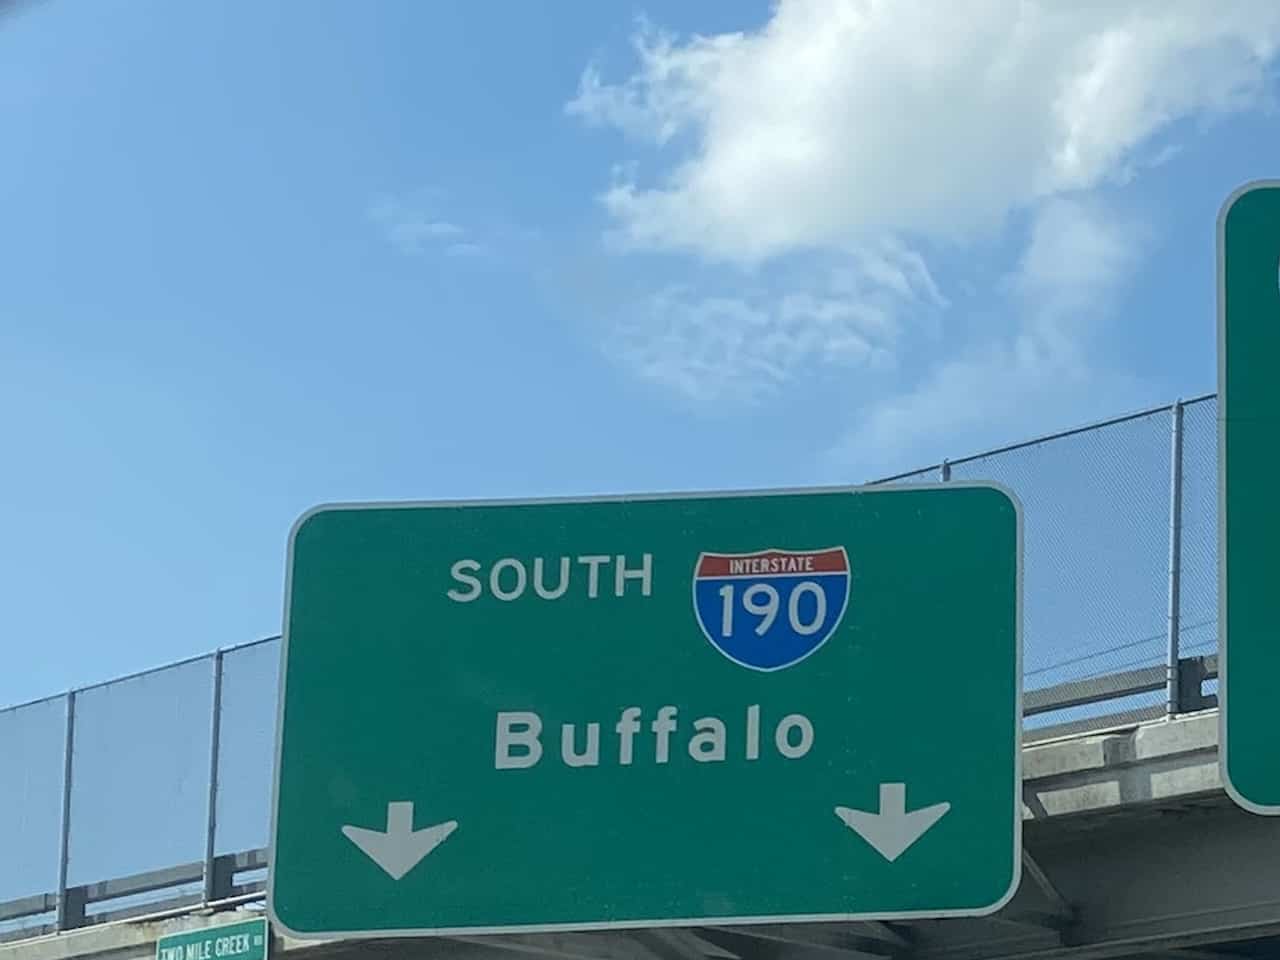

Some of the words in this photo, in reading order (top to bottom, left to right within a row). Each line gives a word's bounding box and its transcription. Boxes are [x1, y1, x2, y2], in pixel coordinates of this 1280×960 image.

[447, 553, 653, 603] SOUTH
[729, 556, 815, 574] INTERSTATE
[719, 581, 827, 637] 190
[494, 704, 815, 770] Buffalo
[215, 933, 250, 957] CREEK
